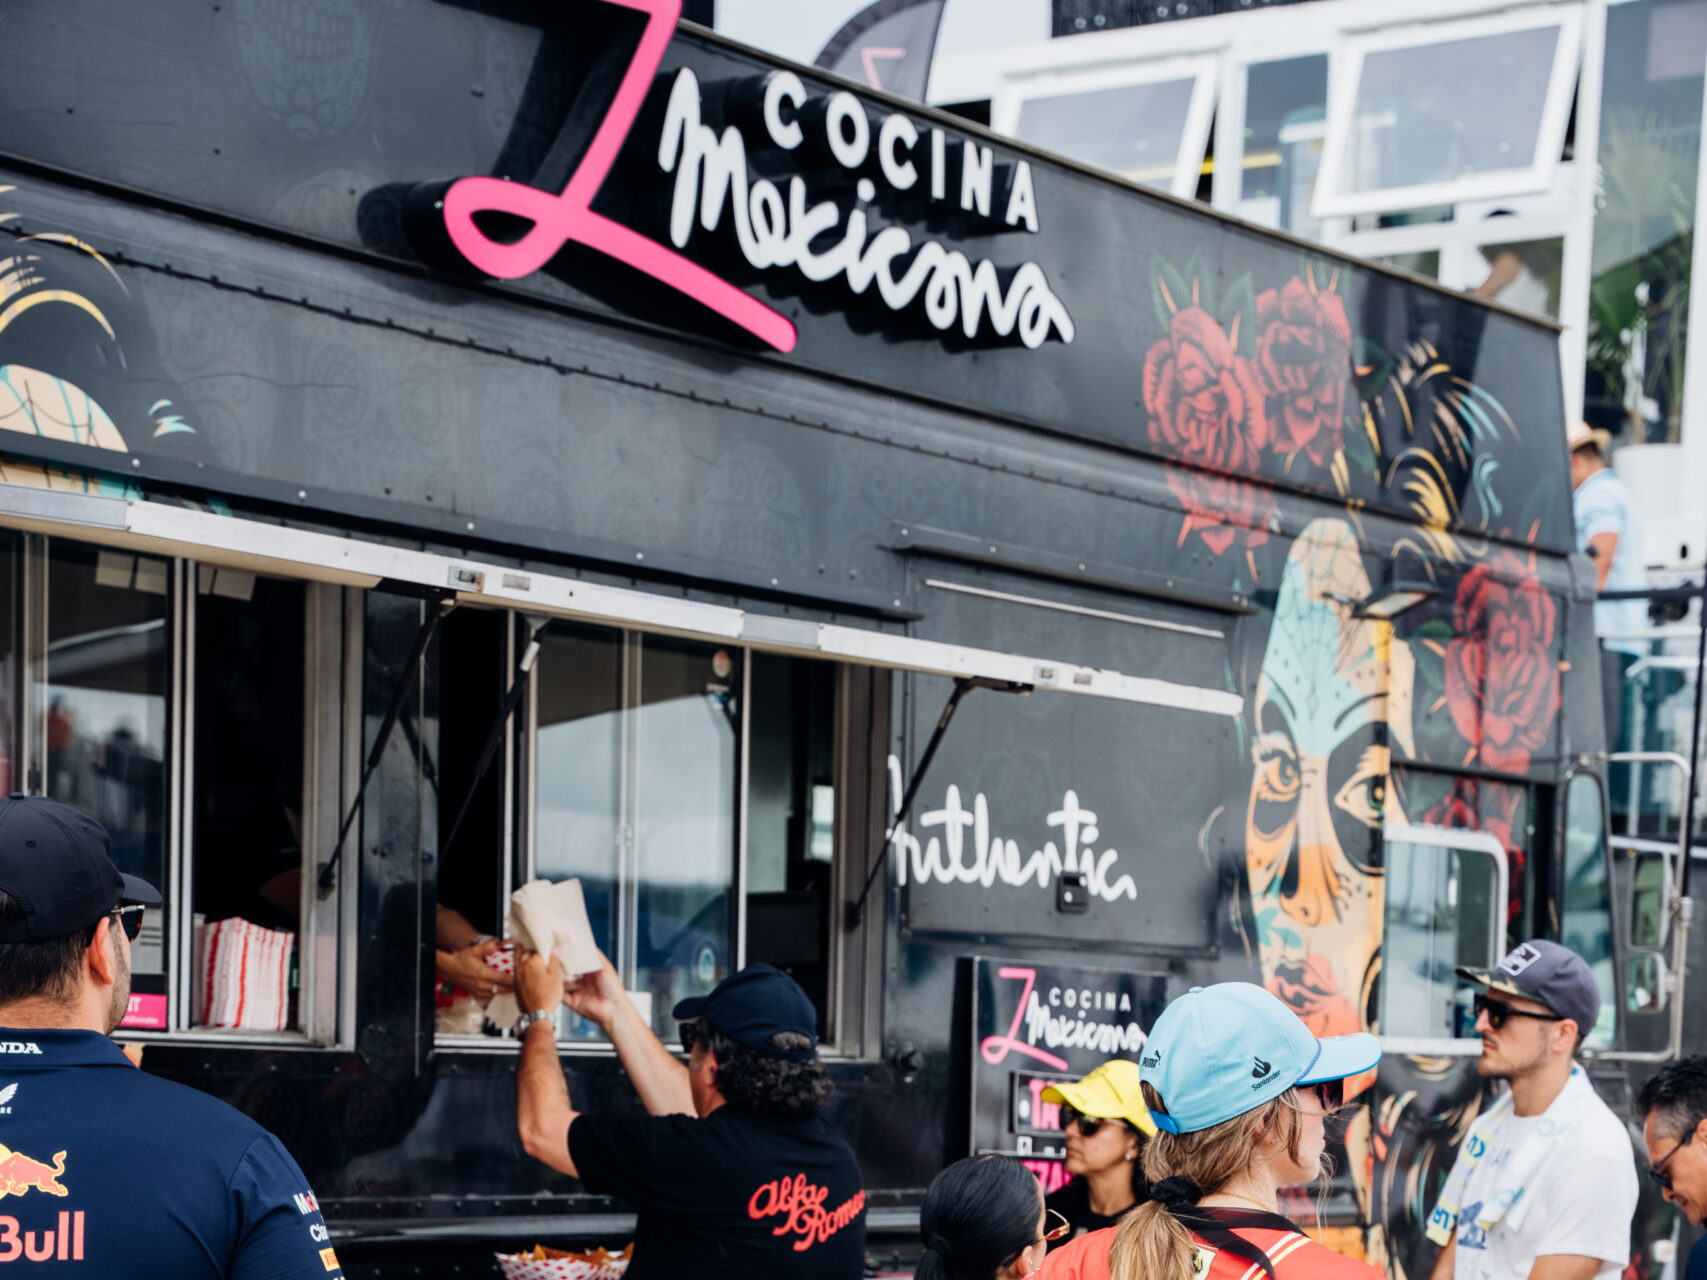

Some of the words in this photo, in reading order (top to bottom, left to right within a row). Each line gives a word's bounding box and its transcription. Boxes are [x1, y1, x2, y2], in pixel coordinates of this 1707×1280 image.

[764, 70, 1040, 233] COCINA
[658, 66, 1075, 349] Mexicana
[1049, 987, 1131, 1012] COCINA
[1252, 1070, 1281, 1091] Santander
[747, 1172, 829, 1236] Alfa
[0, 1211, 85, 1262] Bull
